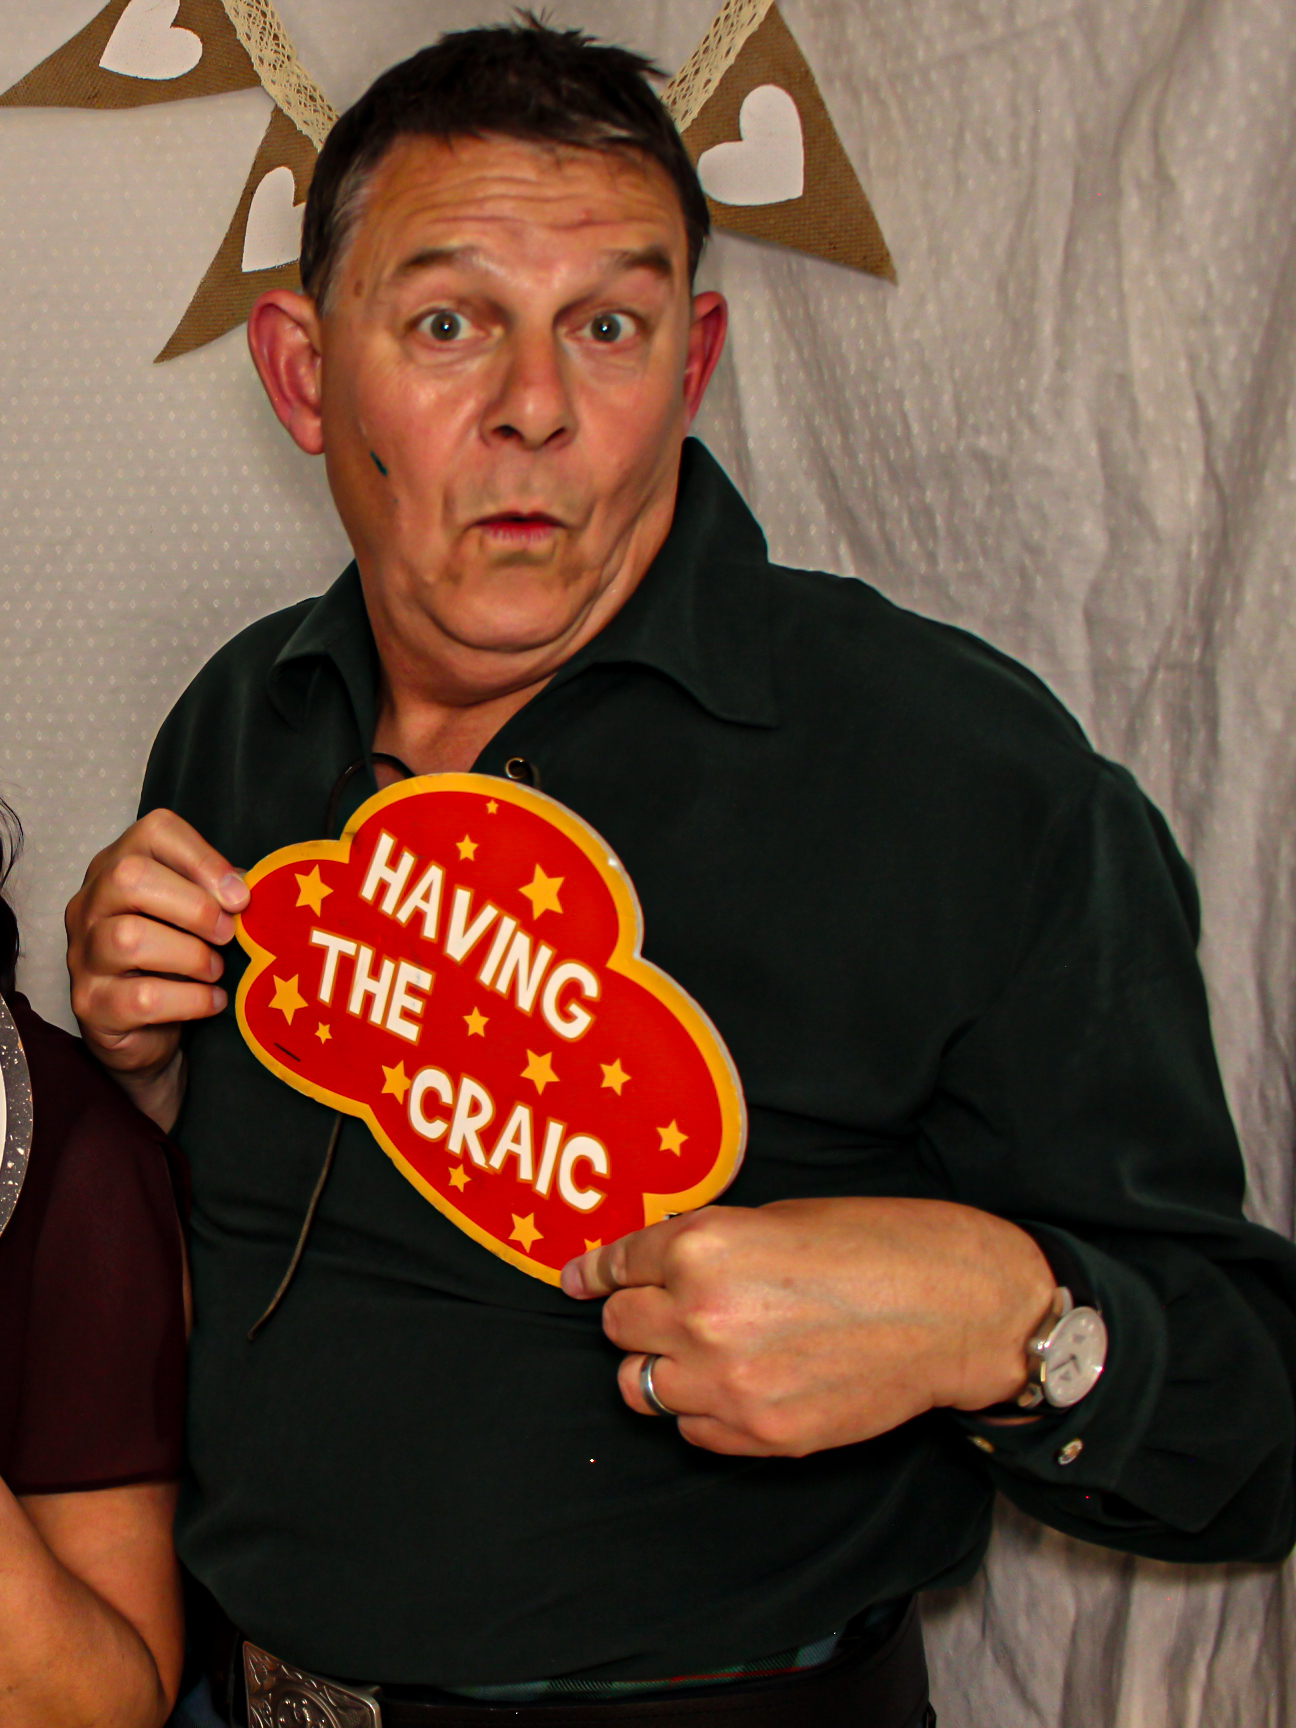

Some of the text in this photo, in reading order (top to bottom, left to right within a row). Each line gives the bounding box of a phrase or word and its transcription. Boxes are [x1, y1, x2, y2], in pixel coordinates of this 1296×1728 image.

[311, 929, 433, 1043] THE
[361, 831, 599, 1040] HAVING
[409, 1068, 609, 1211] CRAIC
